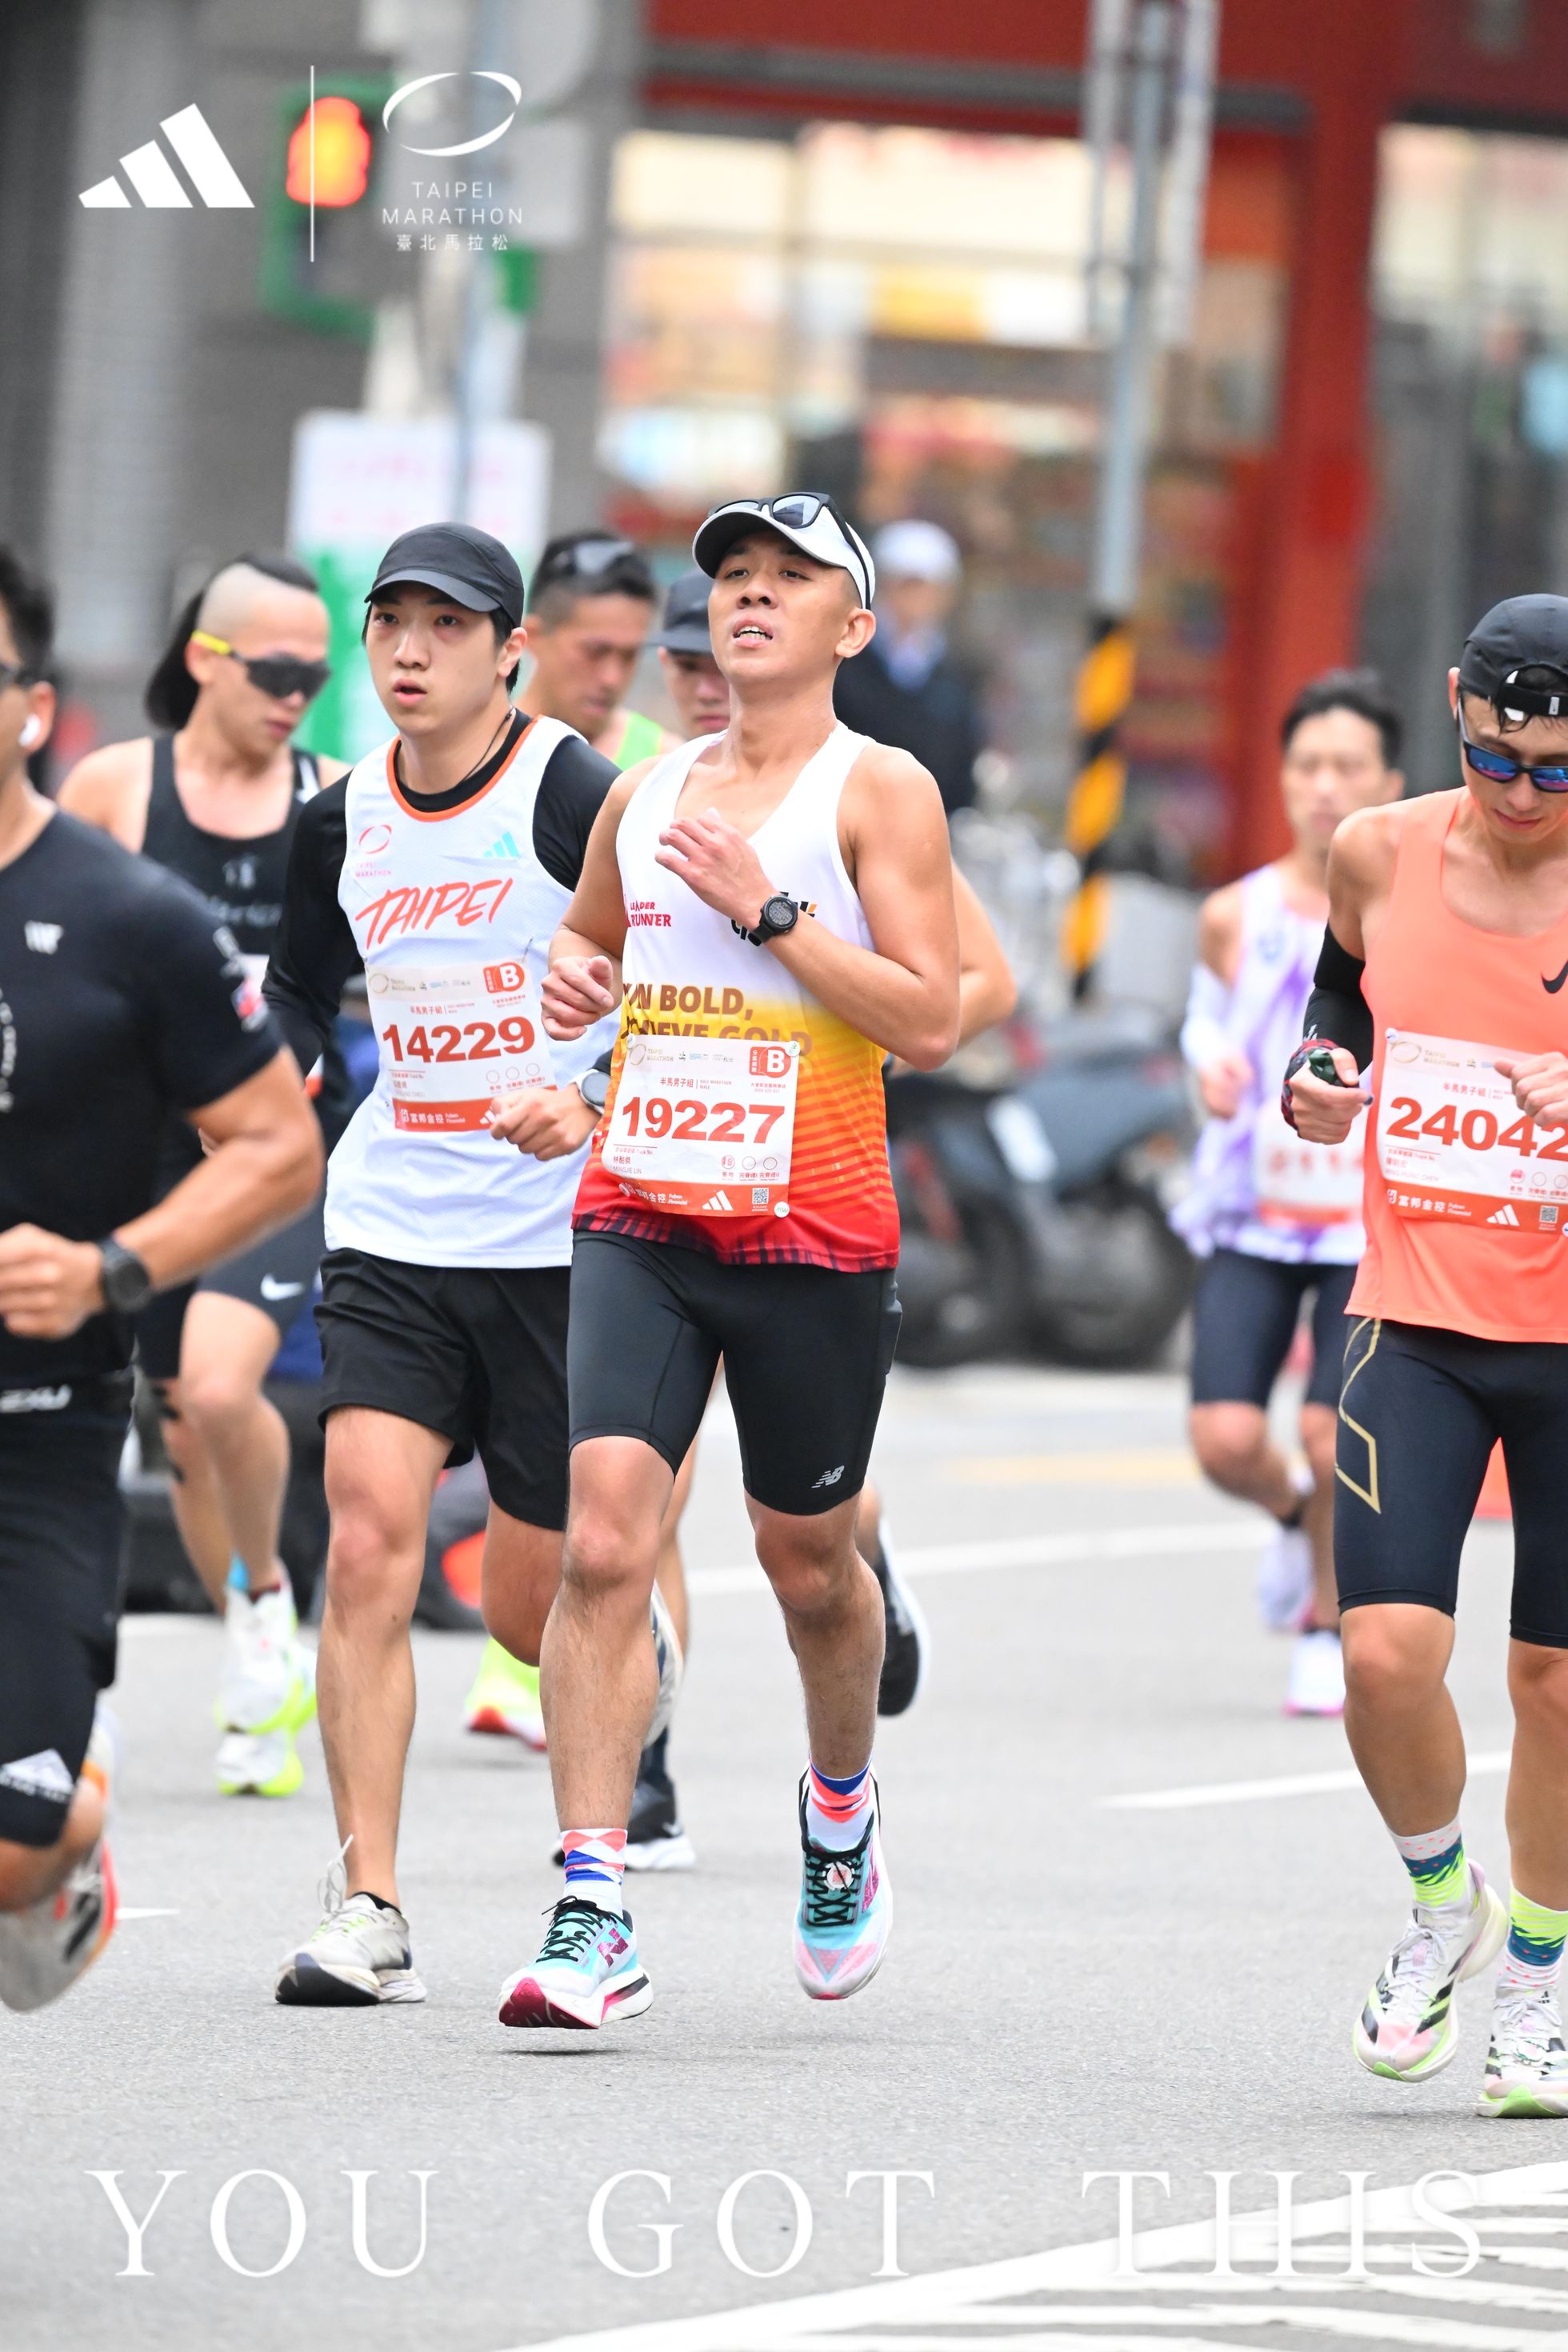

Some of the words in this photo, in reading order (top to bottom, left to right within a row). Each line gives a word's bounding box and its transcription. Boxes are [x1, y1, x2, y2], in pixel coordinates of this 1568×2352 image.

[355, 878, 514, 950] TAIPEI
[630, 900, 655, 911] LEADER
[630, 914, 672, 927] RUNNER
[499, 965, 520, 988] B
[659, 984, 754, 1021] BOLD,
[382, 1016, 535, 1063] 14229
[766, 1050, 785, 1073] B
[660, 1077, 694, 1088] 半馬男子組
[622, 1097, 785, 1143] 19227
[1386, 1097, 1568, 1161] 24042
[1398, 1195, 1446, 1213] 富邦金控
